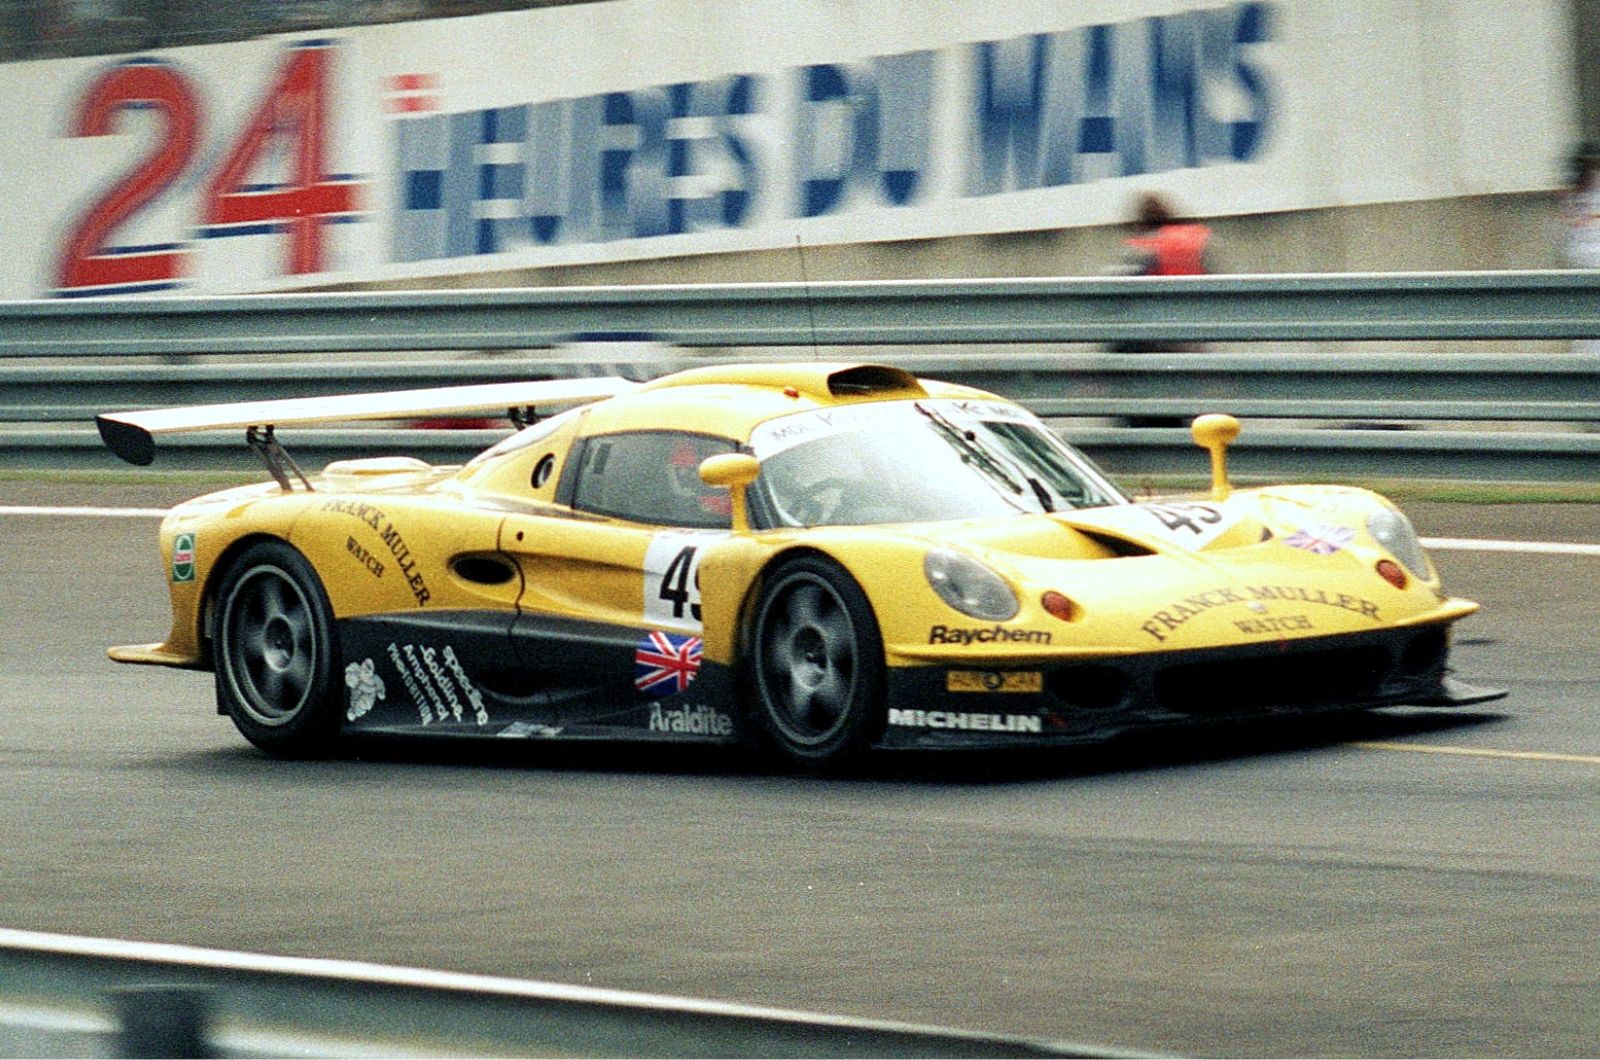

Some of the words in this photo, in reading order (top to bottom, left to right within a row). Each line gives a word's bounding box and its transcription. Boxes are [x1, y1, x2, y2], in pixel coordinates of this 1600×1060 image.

[52, 37, 366, 296] 24
[966, 2, 1278, 196] MANS
[346, 535, 385, 578] WATCH
[380, 523, 430, 607] MULLER
[659, 545, 702, 622] 4
[929, 624, 1053, 645] Raychem
[1141, 586, 1246, 642] FRANCK
[1246, 585, 1382, 622] MULLER
[1233, 614, 1314, 634] WATCH
[403, 644, 449, 721] Amphenol
[649, 701, 733, 735] Araldite
[888, 707, 1042, 732] MICHELIN
